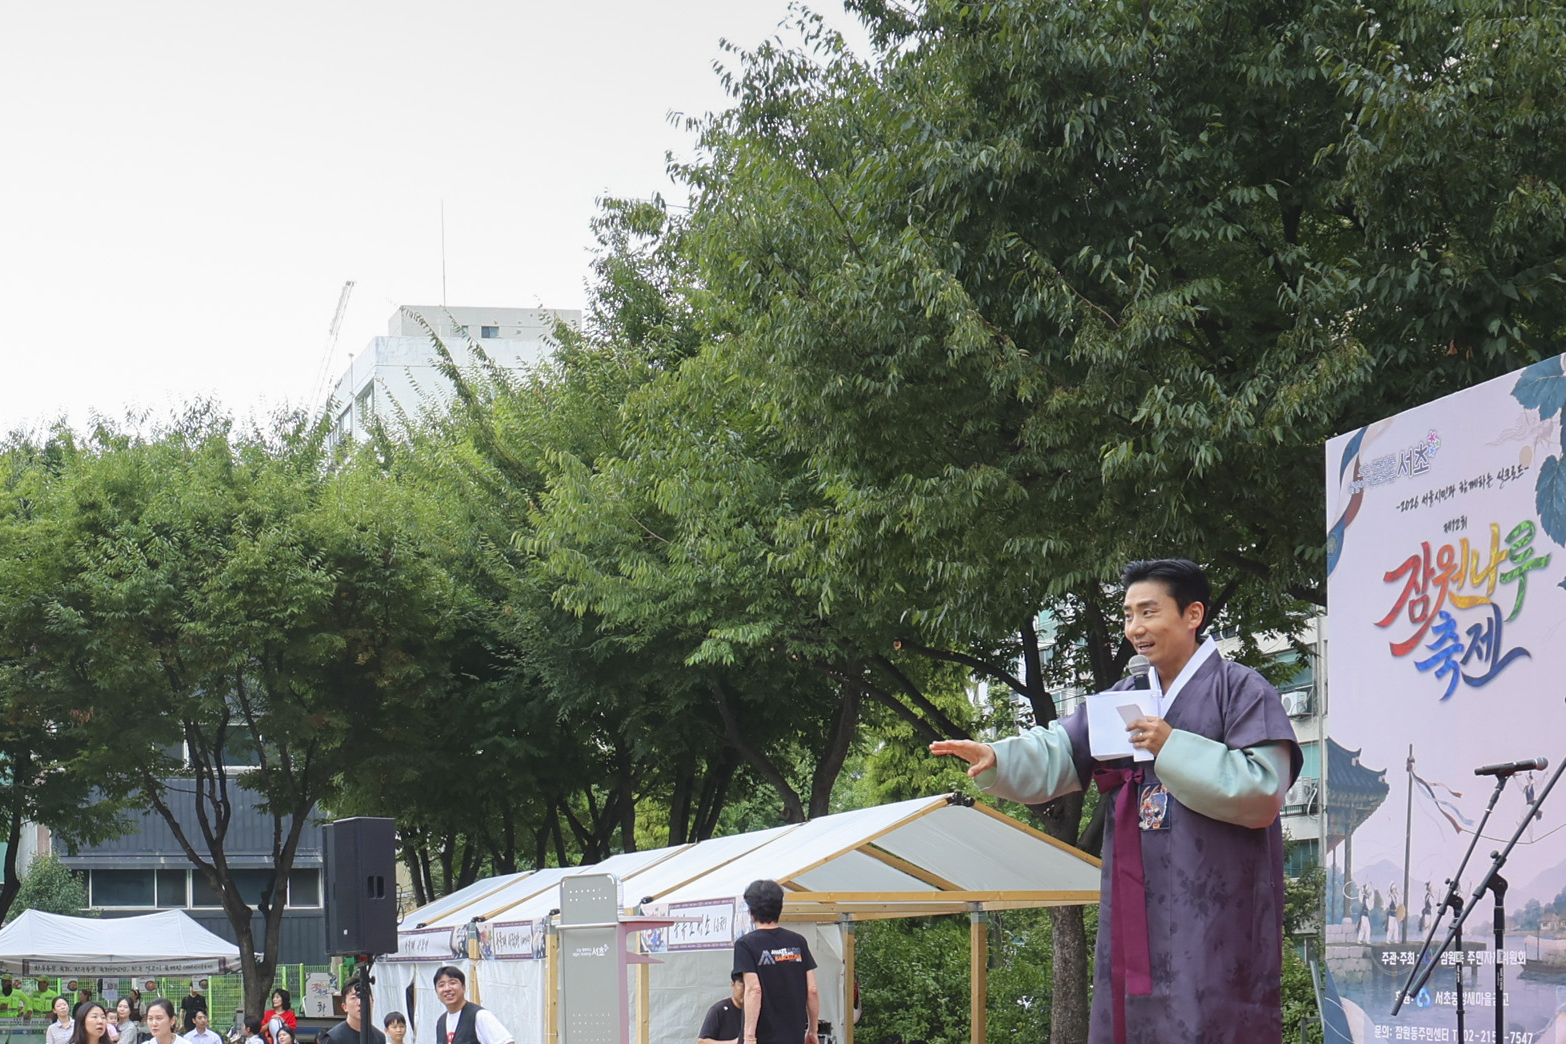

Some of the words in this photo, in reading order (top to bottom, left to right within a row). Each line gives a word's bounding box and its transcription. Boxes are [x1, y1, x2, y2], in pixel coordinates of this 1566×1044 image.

[1397, 442, 1430, 478] 서초
[1421, 484, 1456, 508] 서울시민과
[1458, 471, 1494, 495] 함께하는
[1442, 515, 1468, 534] 제12회
[1373, 520, 1552, 657] 잠원나루
[1413, 602, 1532, 702] 축제
[1395, 1025, 1449, 1042] 잠원동주민센터
